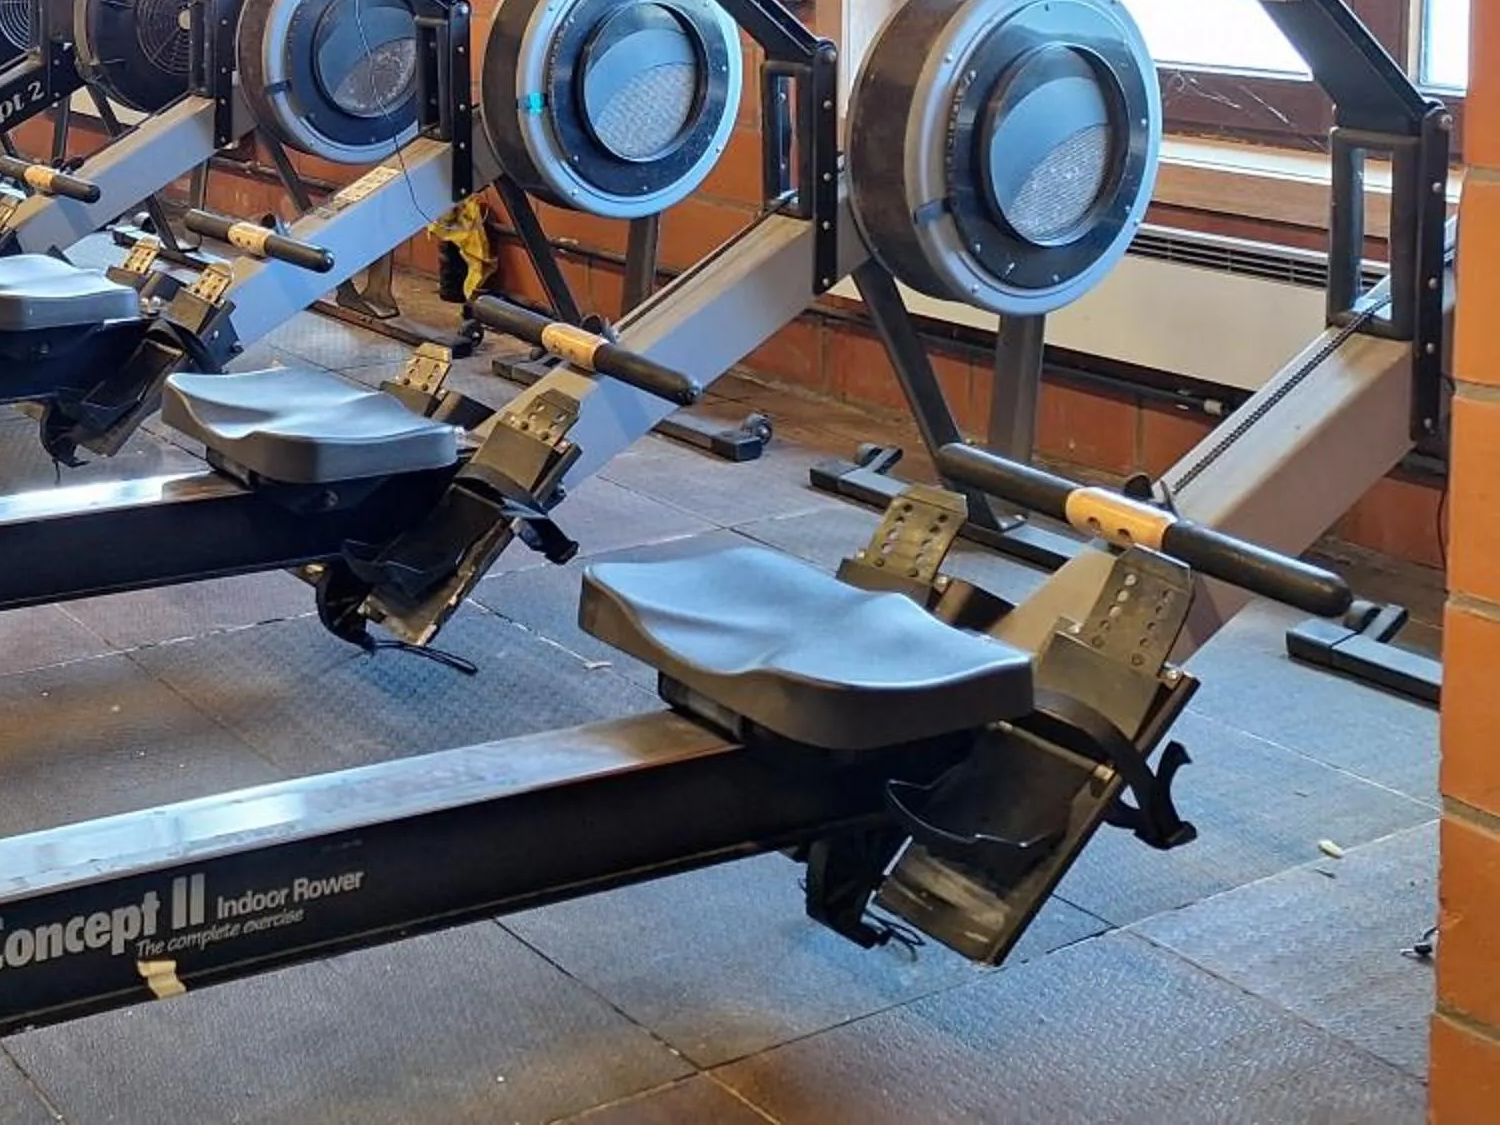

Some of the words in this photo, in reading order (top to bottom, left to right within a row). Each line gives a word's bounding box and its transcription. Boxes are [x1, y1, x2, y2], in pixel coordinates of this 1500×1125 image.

[27, 79, 46, 102] 2
[216, 887, 290, 922] Indoor
[292, 869, 364, 903] Rower
[136, 936, 167, 958] The
[167, 922, 241, 956] complete
[241, 907, 305, 935] exercise
